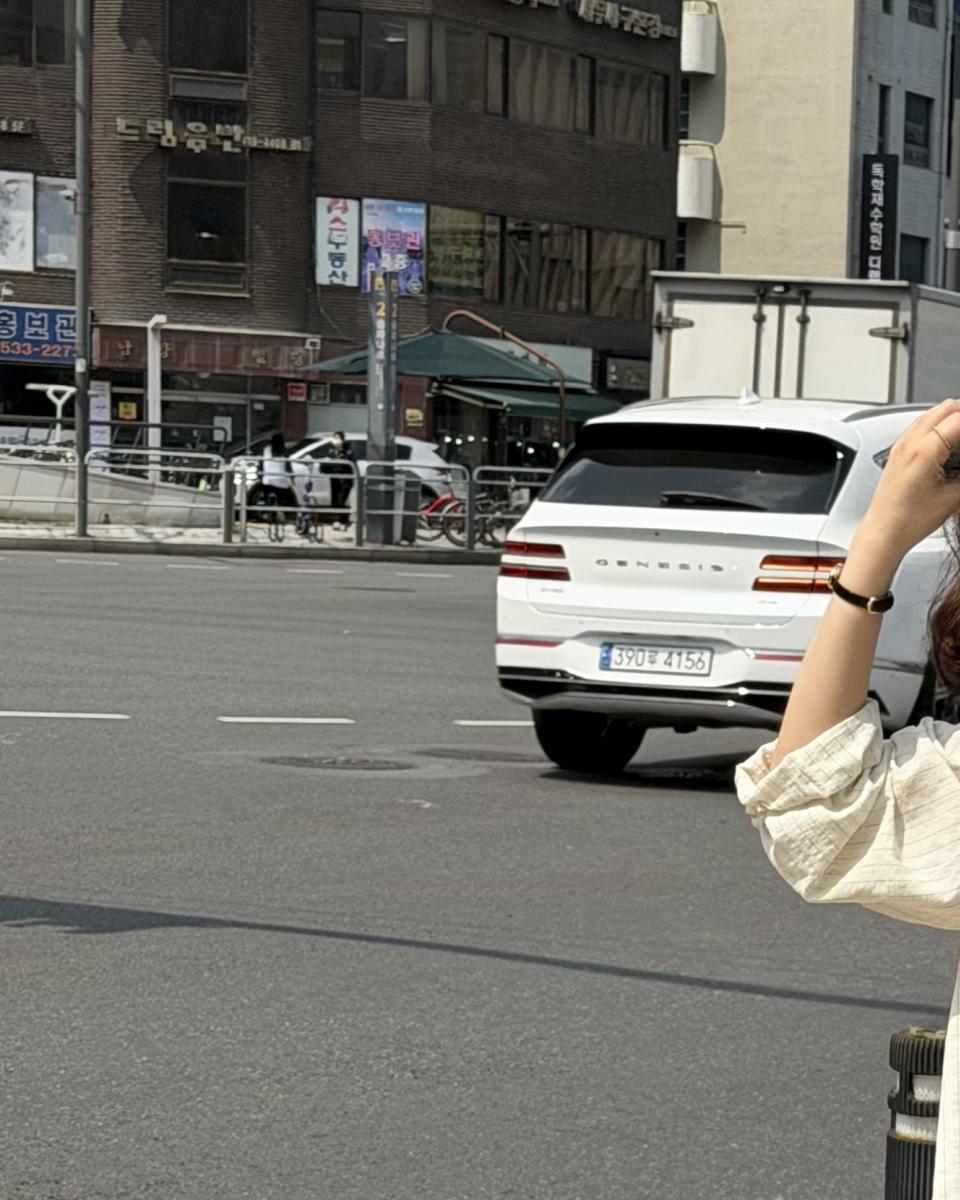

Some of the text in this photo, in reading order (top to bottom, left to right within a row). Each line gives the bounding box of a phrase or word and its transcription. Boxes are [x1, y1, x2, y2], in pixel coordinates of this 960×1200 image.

[870, 162, 885, 251] 독학재수학원
[596, 557, 724, 573] GENESIS
[663, 650, 706, 671] 4156
